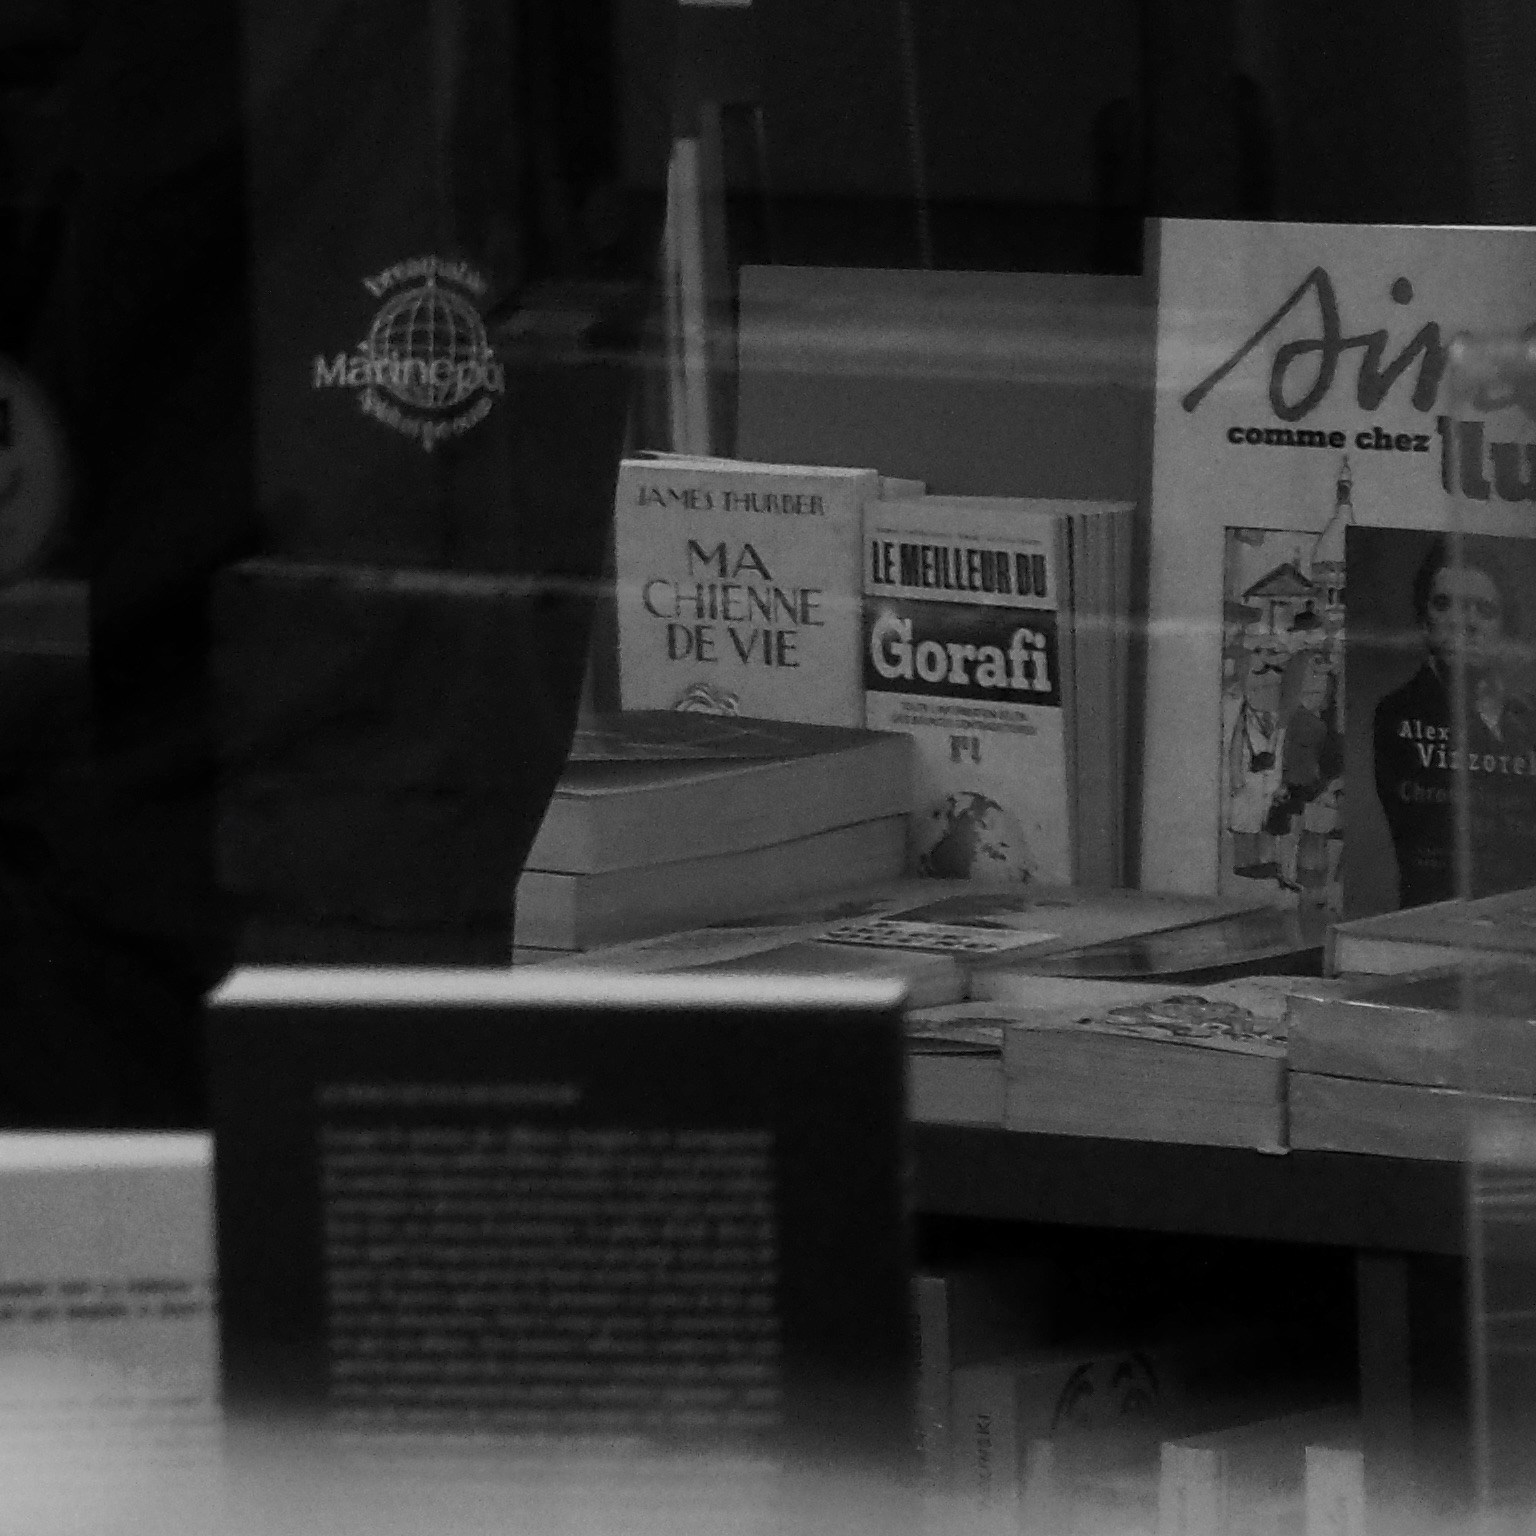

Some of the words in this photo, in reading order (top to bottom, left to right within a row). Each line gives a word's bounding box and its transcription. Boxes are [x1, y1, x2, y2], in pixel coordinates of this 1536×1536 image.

[1228, 425, 1347, 450] comme
[1355, 426, 1431, 453] chez
[637, 485, 714, 511] JAMES
[721, 490, 826, 517] THURBER
[686, 537, 774, 582] MA
[871, 540, 896, 584] LE
[898, 543, 1014, 595] MEILLEUR
[1014, 552, 1049, 598] DU
[641, 578, 826, 627] CHIENNE
[665, 622, 718, 663] DE
[727, 626, 801, 668] VIE
[870, 612, 1053, 693] Gorafi
